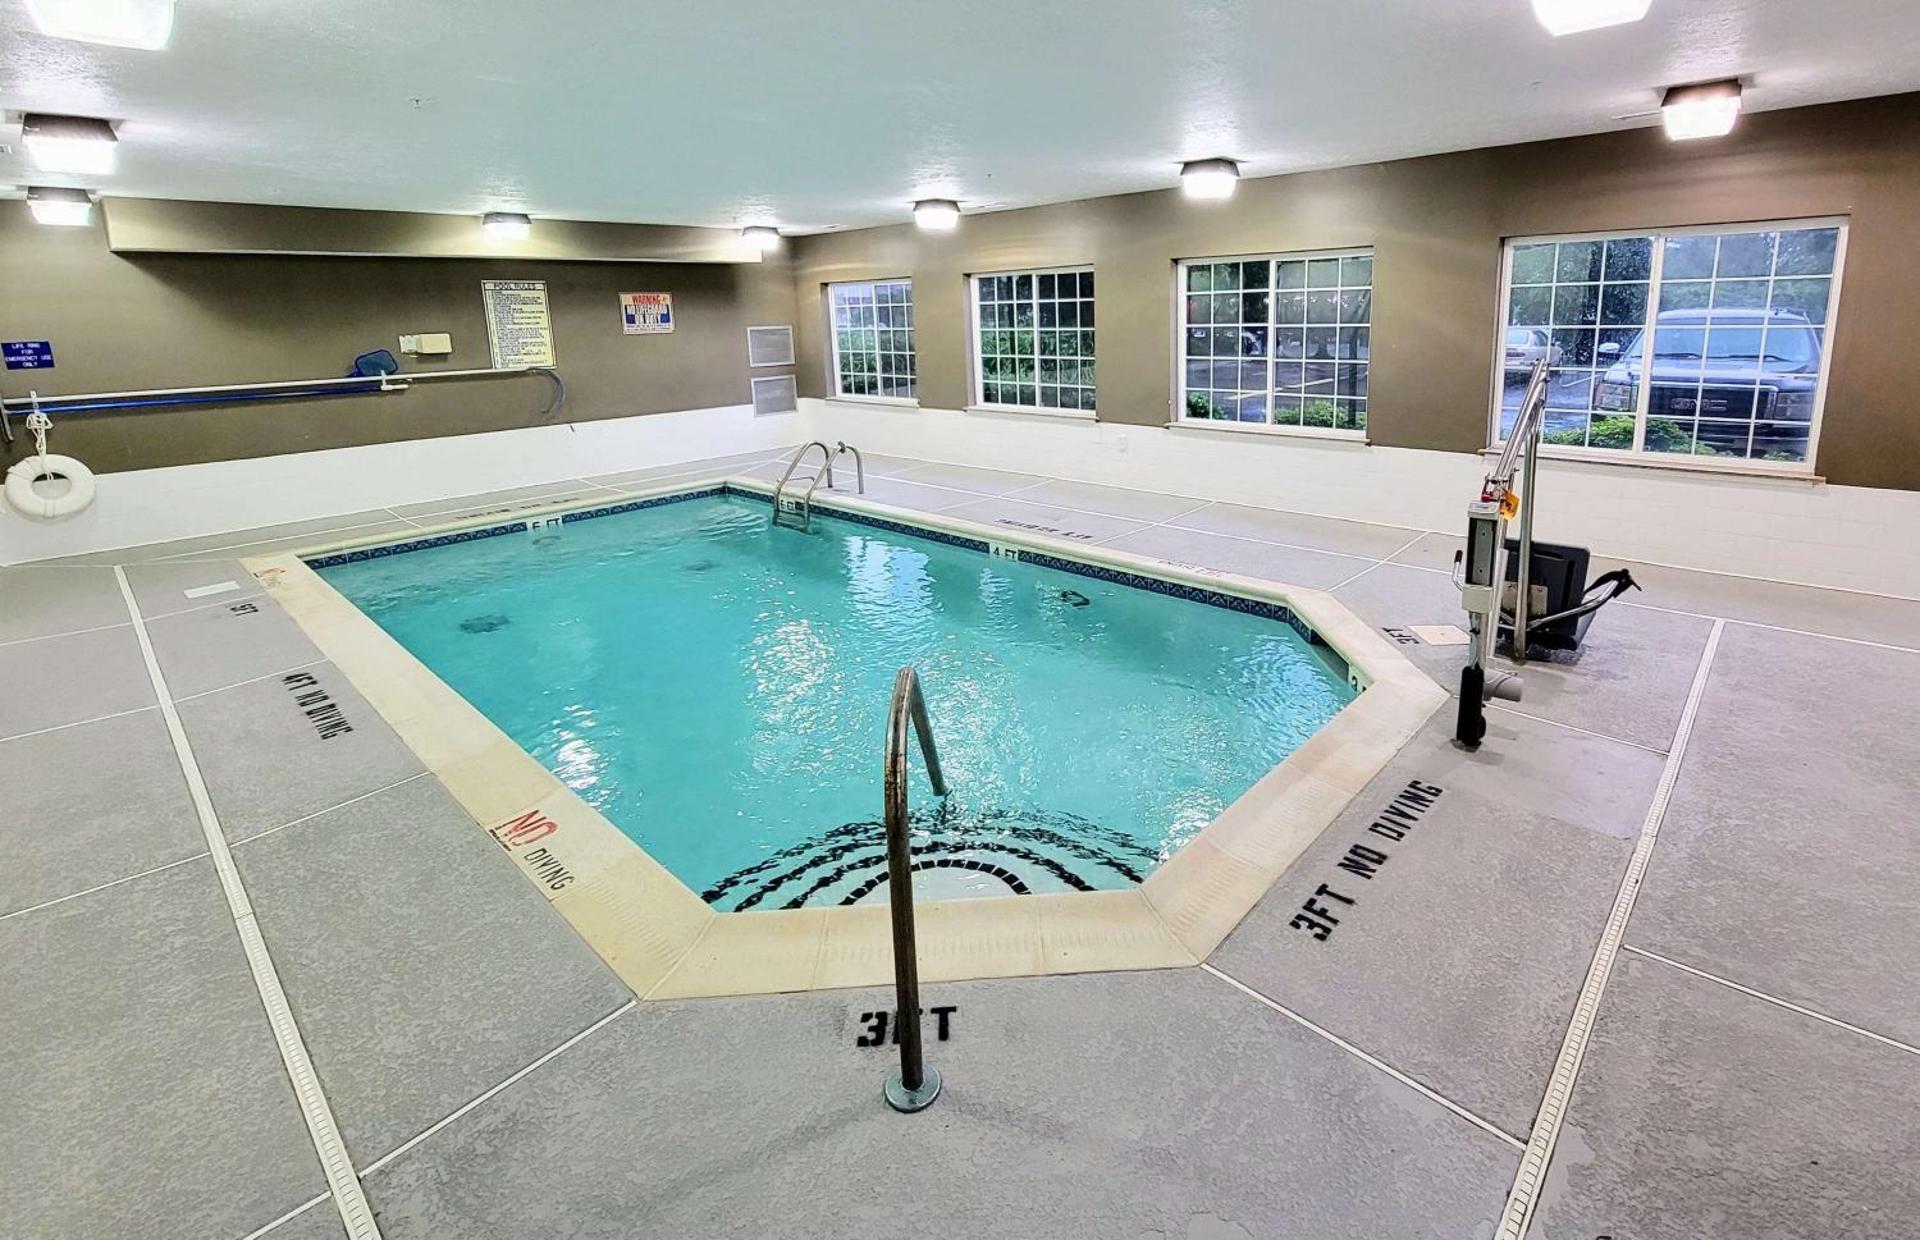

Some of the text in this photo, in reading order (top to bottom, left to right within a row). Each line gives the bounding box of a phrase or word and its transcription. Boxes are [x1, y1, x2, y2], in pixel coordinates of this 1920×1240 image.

[494, 282, 536, 290] POOL RULES
[282, 672, 354, 741] 4FT NO DIVING
[495, 809, 557, 847] NO
[523, 847, 576, 890] DIVING
[1289, 780, 1443, 942] 3FT NO DIVING
[856, 1006, 958, 1048] 3T
